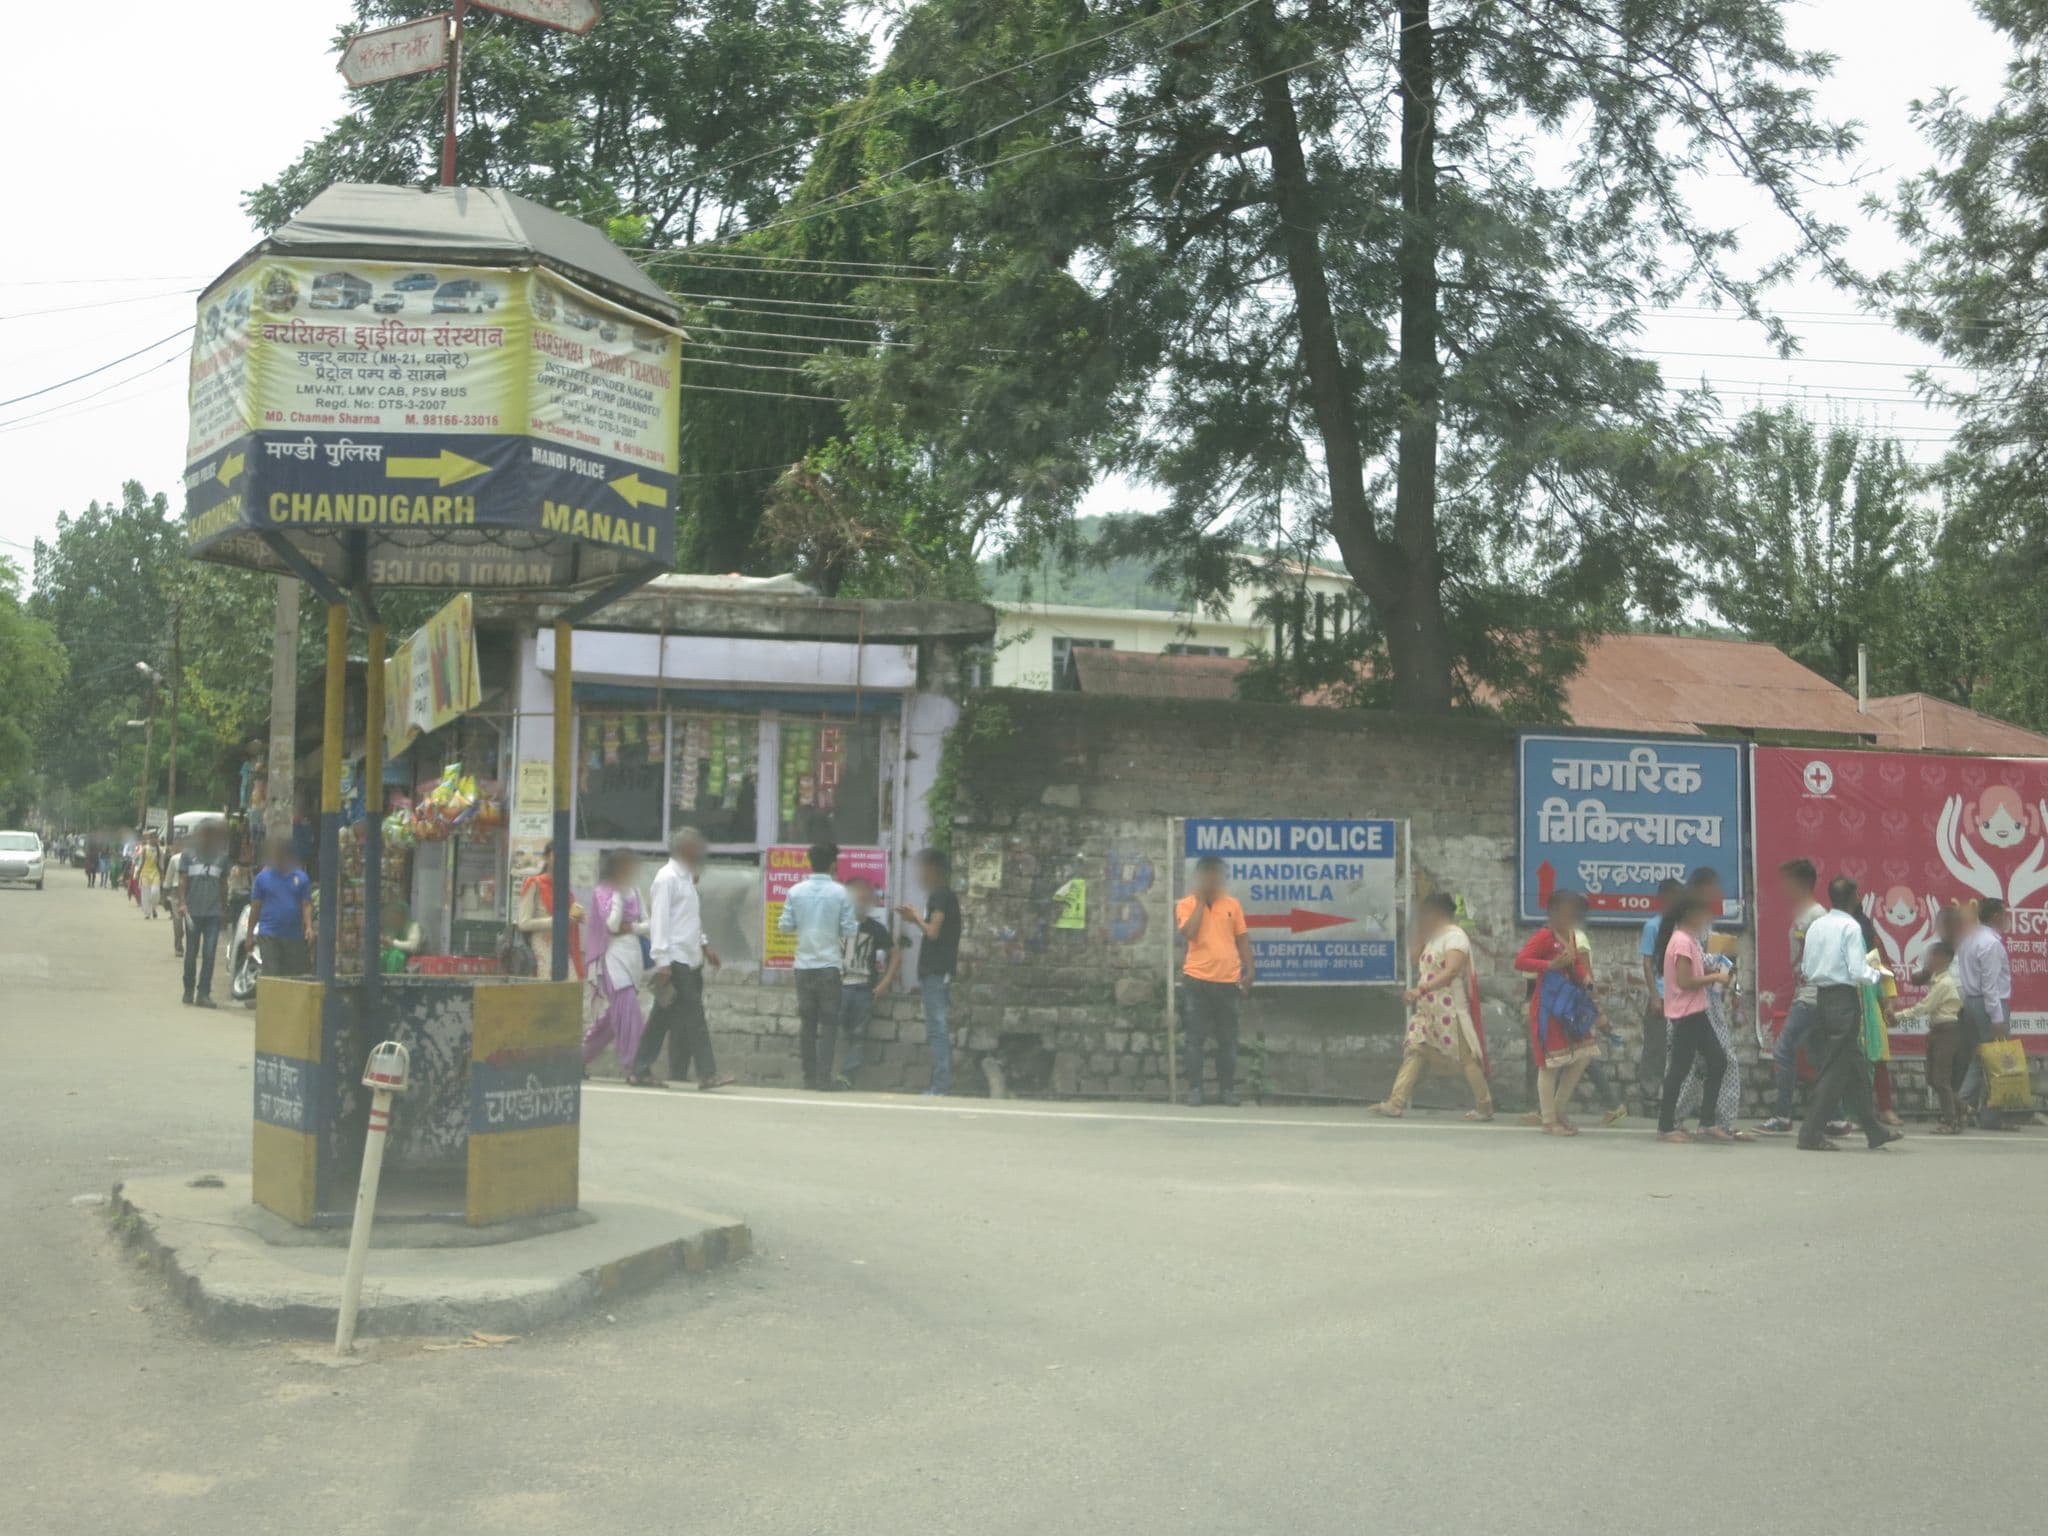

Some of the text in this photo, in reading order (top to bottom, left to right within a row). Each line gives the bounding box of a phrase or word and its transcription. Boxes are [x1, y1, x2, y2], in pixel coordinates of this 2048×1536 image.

[432, 321, 505, 347] संस्थान
[297, 351, 335, 367] सुन्दर
[337, 352, 368, 364] नगर
[389, 365, 402, 380] के
[407, 365, 447, 381] सामने
[630, 359, 672, 389] TRAINING
[349, 386, 375, 397] LMV
[413, 387, 437, 398] PSV
[441, 387, 468, 398] BUS
[378, 400, 447, 411] DTS-3-2007
[290, 412, 335, 425] Chaman
[339, 413, 381, 425] Sharma
[264, 436, 317, 461] मण्डी
[324, 438, 384, 466] पुलिस
[531, 446, 606, 481] MANDI POLICE
[269, 491, 476, 524] CHANDIGARH
[541, 500, 657, 553] MANALI
[1552, 748, 1702, 794] नागरिक
[1196, 826, 1383, 850] MANDI POLICE
[1227, 864, 1364, 881] HANDIGARH
[1250, 885, 1334, 901] SHIMLA
[1618, 897, 1650, 908] 100
[1269, 943, 1321, 957] DENTAL
[1325, 943, 1388, 957] COLLEGE
[2031, 959, 2048, 974] CHIL
